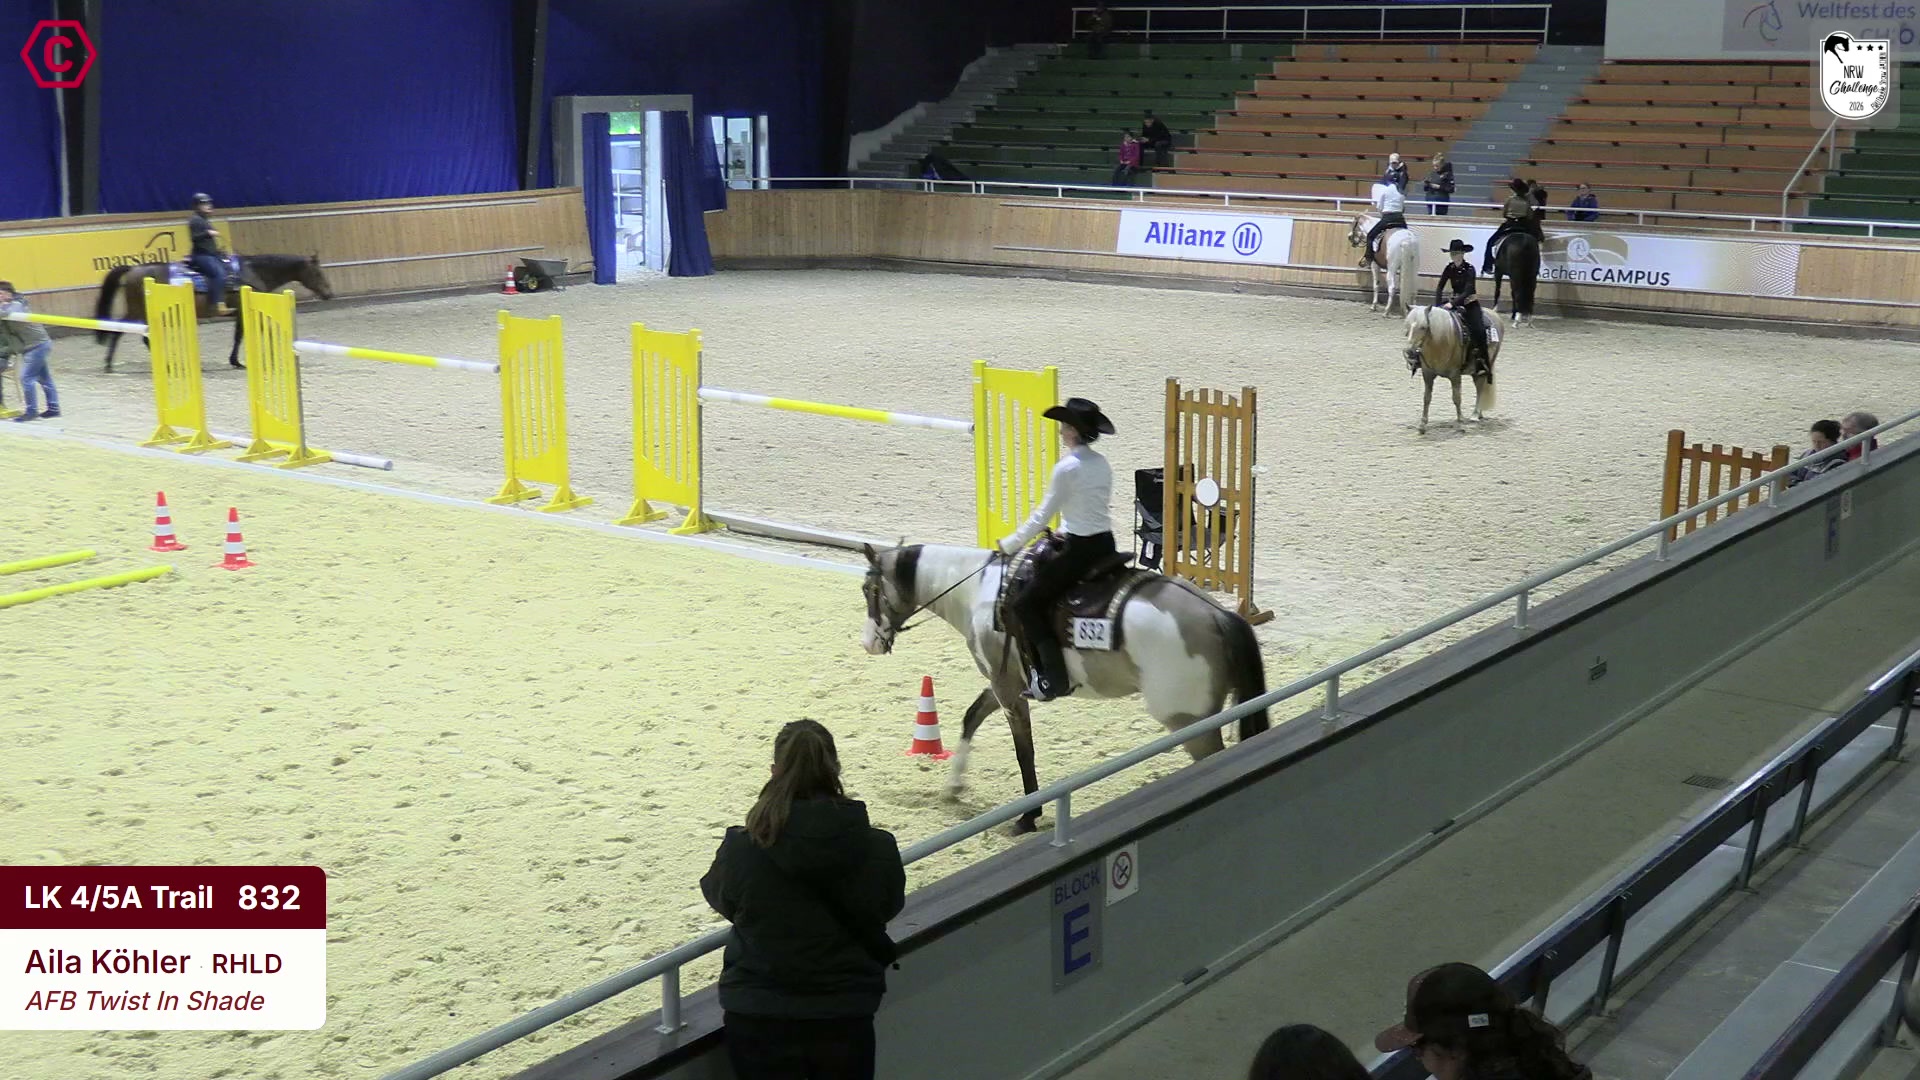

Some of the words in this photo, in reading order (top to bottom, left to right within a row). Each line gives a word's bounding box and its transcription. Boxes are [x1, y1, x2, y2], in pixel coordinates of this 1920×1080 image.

[1799, 2, 1877, 18] Weltfest
[1883, 2, 1916, 18] des
[1144, 221, 1226, 248] Allianz
[93, 248, 169, 271] marstall
[1590, 267, 1671, 286] CAMPUS
[1079, 621, 1104, 641] 832
[1055, 870, 1100, 905] BLOCK
[1064, 903, 1091, 975] E
